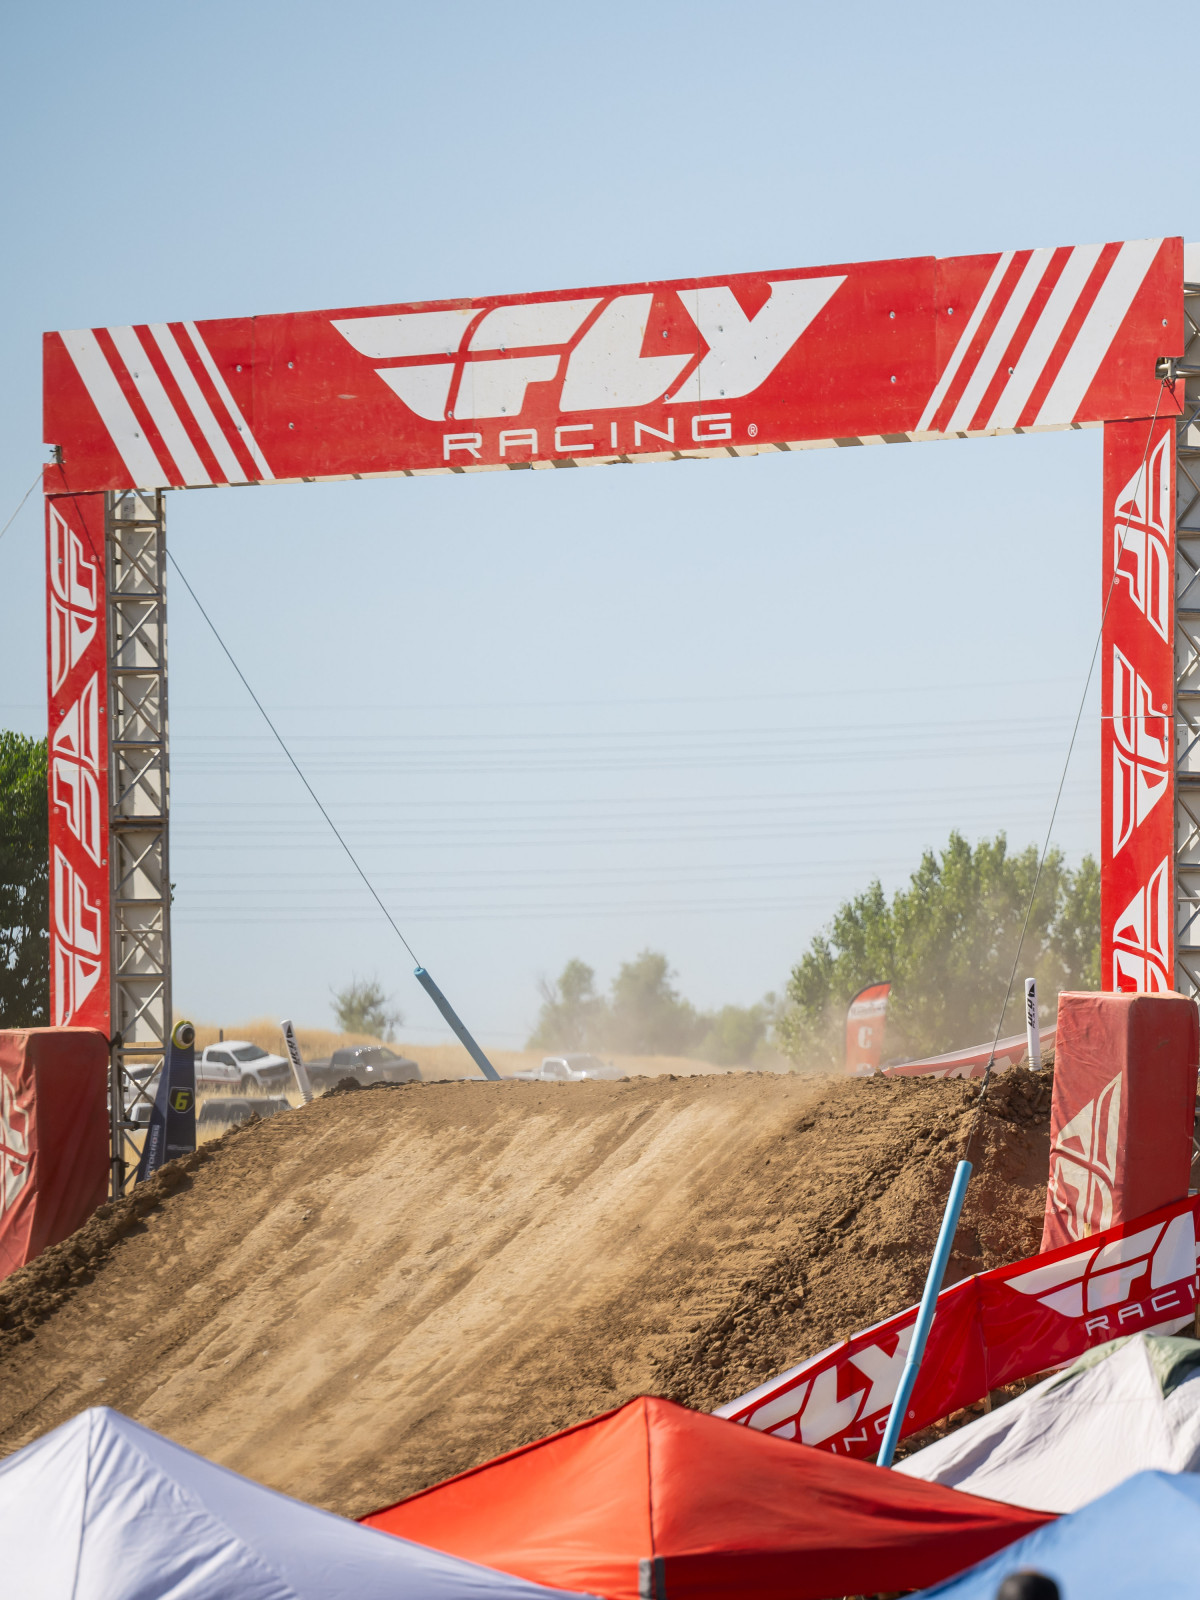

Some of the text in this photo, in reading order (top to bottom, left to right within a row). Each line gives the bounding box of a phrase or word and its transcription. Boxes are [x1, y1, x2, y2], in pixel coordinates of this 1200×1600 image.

[329, 275, 849, 421] FLY
[442, 413, 733, 460] RACING
[175, 1092, 190, 1110] 6
[144, 1124, 161, 1180] OTOCROSS
